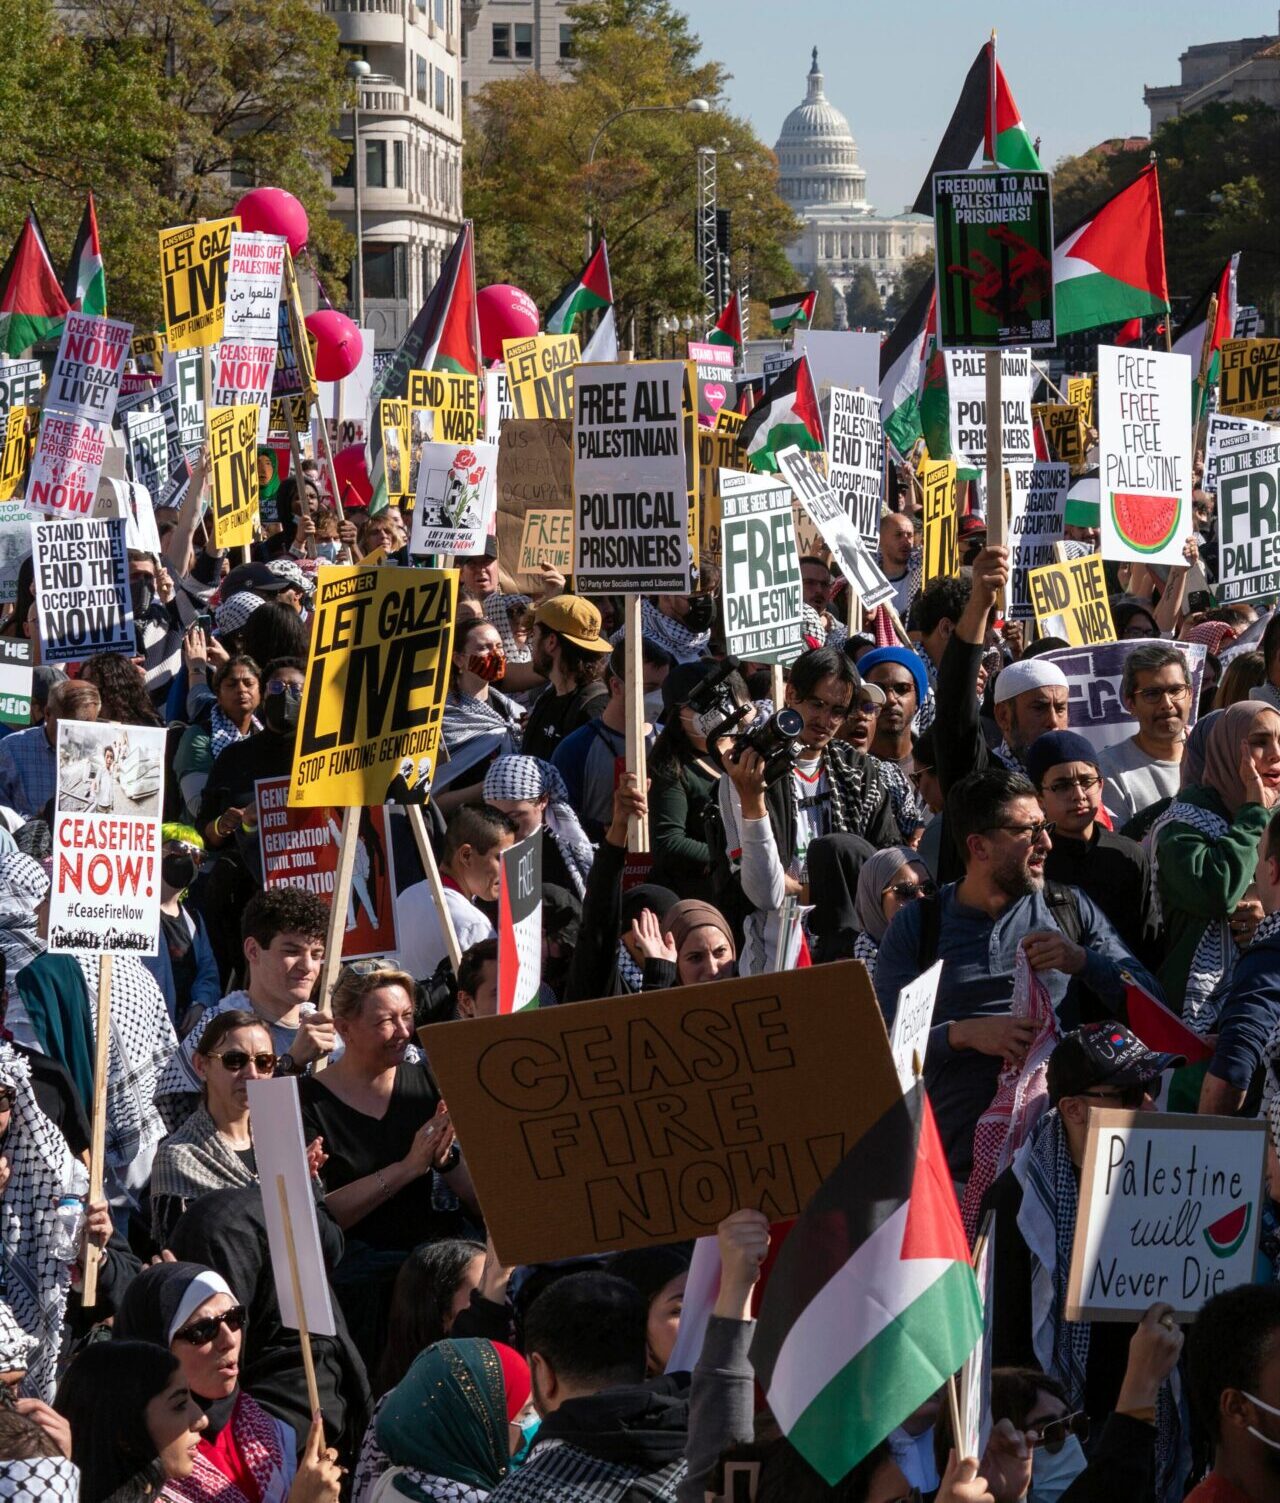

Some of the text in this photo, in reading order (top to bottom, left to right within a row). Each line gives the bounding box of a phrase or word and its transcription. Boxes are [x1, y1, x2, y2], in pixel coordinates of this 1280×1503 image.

[937, 176, 1046, 194] FREEDOM TO ALL
[952, 192, 1032, 209] PALESTINIAN
[955, 207, 1030, 224] PRISONERS!
[163, 229, 195, 247] ANSWER
[234, 243, 283, 259] HANDS OFF
[163, 241, 194, 276] LET
[232, 259, 281, 276] PALESTINE
[230, 288, 244, 301] من
[170, 312, 214, 341] STOP FUNDING
[231, 307, 271, 322] فلسطين
[67, 317, 131, 342] CEASEFIRE
[65, 334, 125, 370] NOW
[219, 344, 275, 363] CEASEFIRE
[508, 341, 535, 357] ANSWER
[509, 338, 580, 385] LET GAZA
[691, 348, 713, 360] STAND
[1222, 350, 1244, 370] LET
[59, 361, 82, 381] LET
[84, 367, 119, 389] GAZA
[219, 362, 270, 390] NOW
[1118, 354, 1157, 390] FREE
[59, 379, 108, 410] LIVE!
[216, 390, 269, 408] LET GAZA
[412, 375, 475, 410] END THE
[578, 379, 677, 426] FREE ALL
[834, 392, 865, 415] STAND
[1070, 388, 1082, 404] LET
[383, 402, 401, 427] END
[1120, 392, 1160, 422] FREE
[45, 418, 105, 444] FREE ALL
[441, 410, 474, 441] WAR
[506, 430, 529, 447] US
[1123, 423, 1162, 454] FREE
[40, 443, 102, 466] PRISONERS
[42, 434, 104, 454] PALESTINIAN
[212, 424, 234, 460] LET
[578, 427, 679, 459] PALESTINIAN
[832, 435, 883, 472] END THE
[1220, 434, 1249, 448] ANSWER
[1107, 453, 1182, 492] PALESTINE
[1220, 457, 1235, 474] END
[1238, 452, 1253, 469] THE
[1255, 446, 1276, 465] SIEGE
[724, 477, 745, 488] ANSWER
[831, 469, 881, 496] OCCUPATION
[1015, 469, 1066, 490] RESISTANCE
[31, 481, 94, 513] NOW
[724, 499, 736, 516] END
[738, 497, 749, 514] THE
[927, 482, 948, 523] LET
[1024, 492, 1057, 512] AGAINST
[579, 491, 681, 531] POLITICAL
[1013, 513, 1063, 535] OCCUPATION
[37, 520, 121, 543] STAND WITH
[525, 513, 572, 546] FREE
[39, 539, 124, 563] PALESTINE!
[522, 545, 570, 568] PALESTINE
[579, 534, 682, 569] PRISONERS
[724, 512, 800, 594] FREE
[1012, 546, 1021, 566] IS
[40, 558, 125, 590] END THE
[323, 576, 375, 599] ANSWER
[587, 578, 684, 589] Party for Socialism and Liberation
[1032, 570, 1070, 616] END
[1070, 559, 1104, 604] THE
[1224, 575, 1277, 599] END ALL U.S.
[42, 587, 126, 611] OCCUPATION
[728, 584, 800, 632] PALESTINE
[45, 604, 128, 648] NOW!
[314, 578, 452, 657] LET GAZA
[1073, 601, 1113, 641] WAR
[732, 637, 743, 654] END
[744, 633, 758, 652] ALL
[760, 629, 775, 649] U.S.
[300, 626, 450, 757] LIVE!
[298, 726, 437, 786] STOP FUNDING GENOCIDE!
[263, 812, 287, 828] AFTER
[59, 819, 155, 852] CEASEFIRE
[265, 827, 330, 853] GENERATION
[58, 852, 153, 898] NOW!
[267, 852, 316, 871] UNTIL TOTAL
[518, 848, 535, 899] FREE
[67, 902, 144, 920] #CeaseFireNow
[477, 996, 795, 1112] CEASE
[519, 1083, 763, 1181] FIRE
[1105, 1135, 1242, 1199] Palestine
[586, 1132, 846, 1243] NOW!
[1130, 1199, 1202, 1247] will
[1089, 1255, 1225, 1300] Never Die
